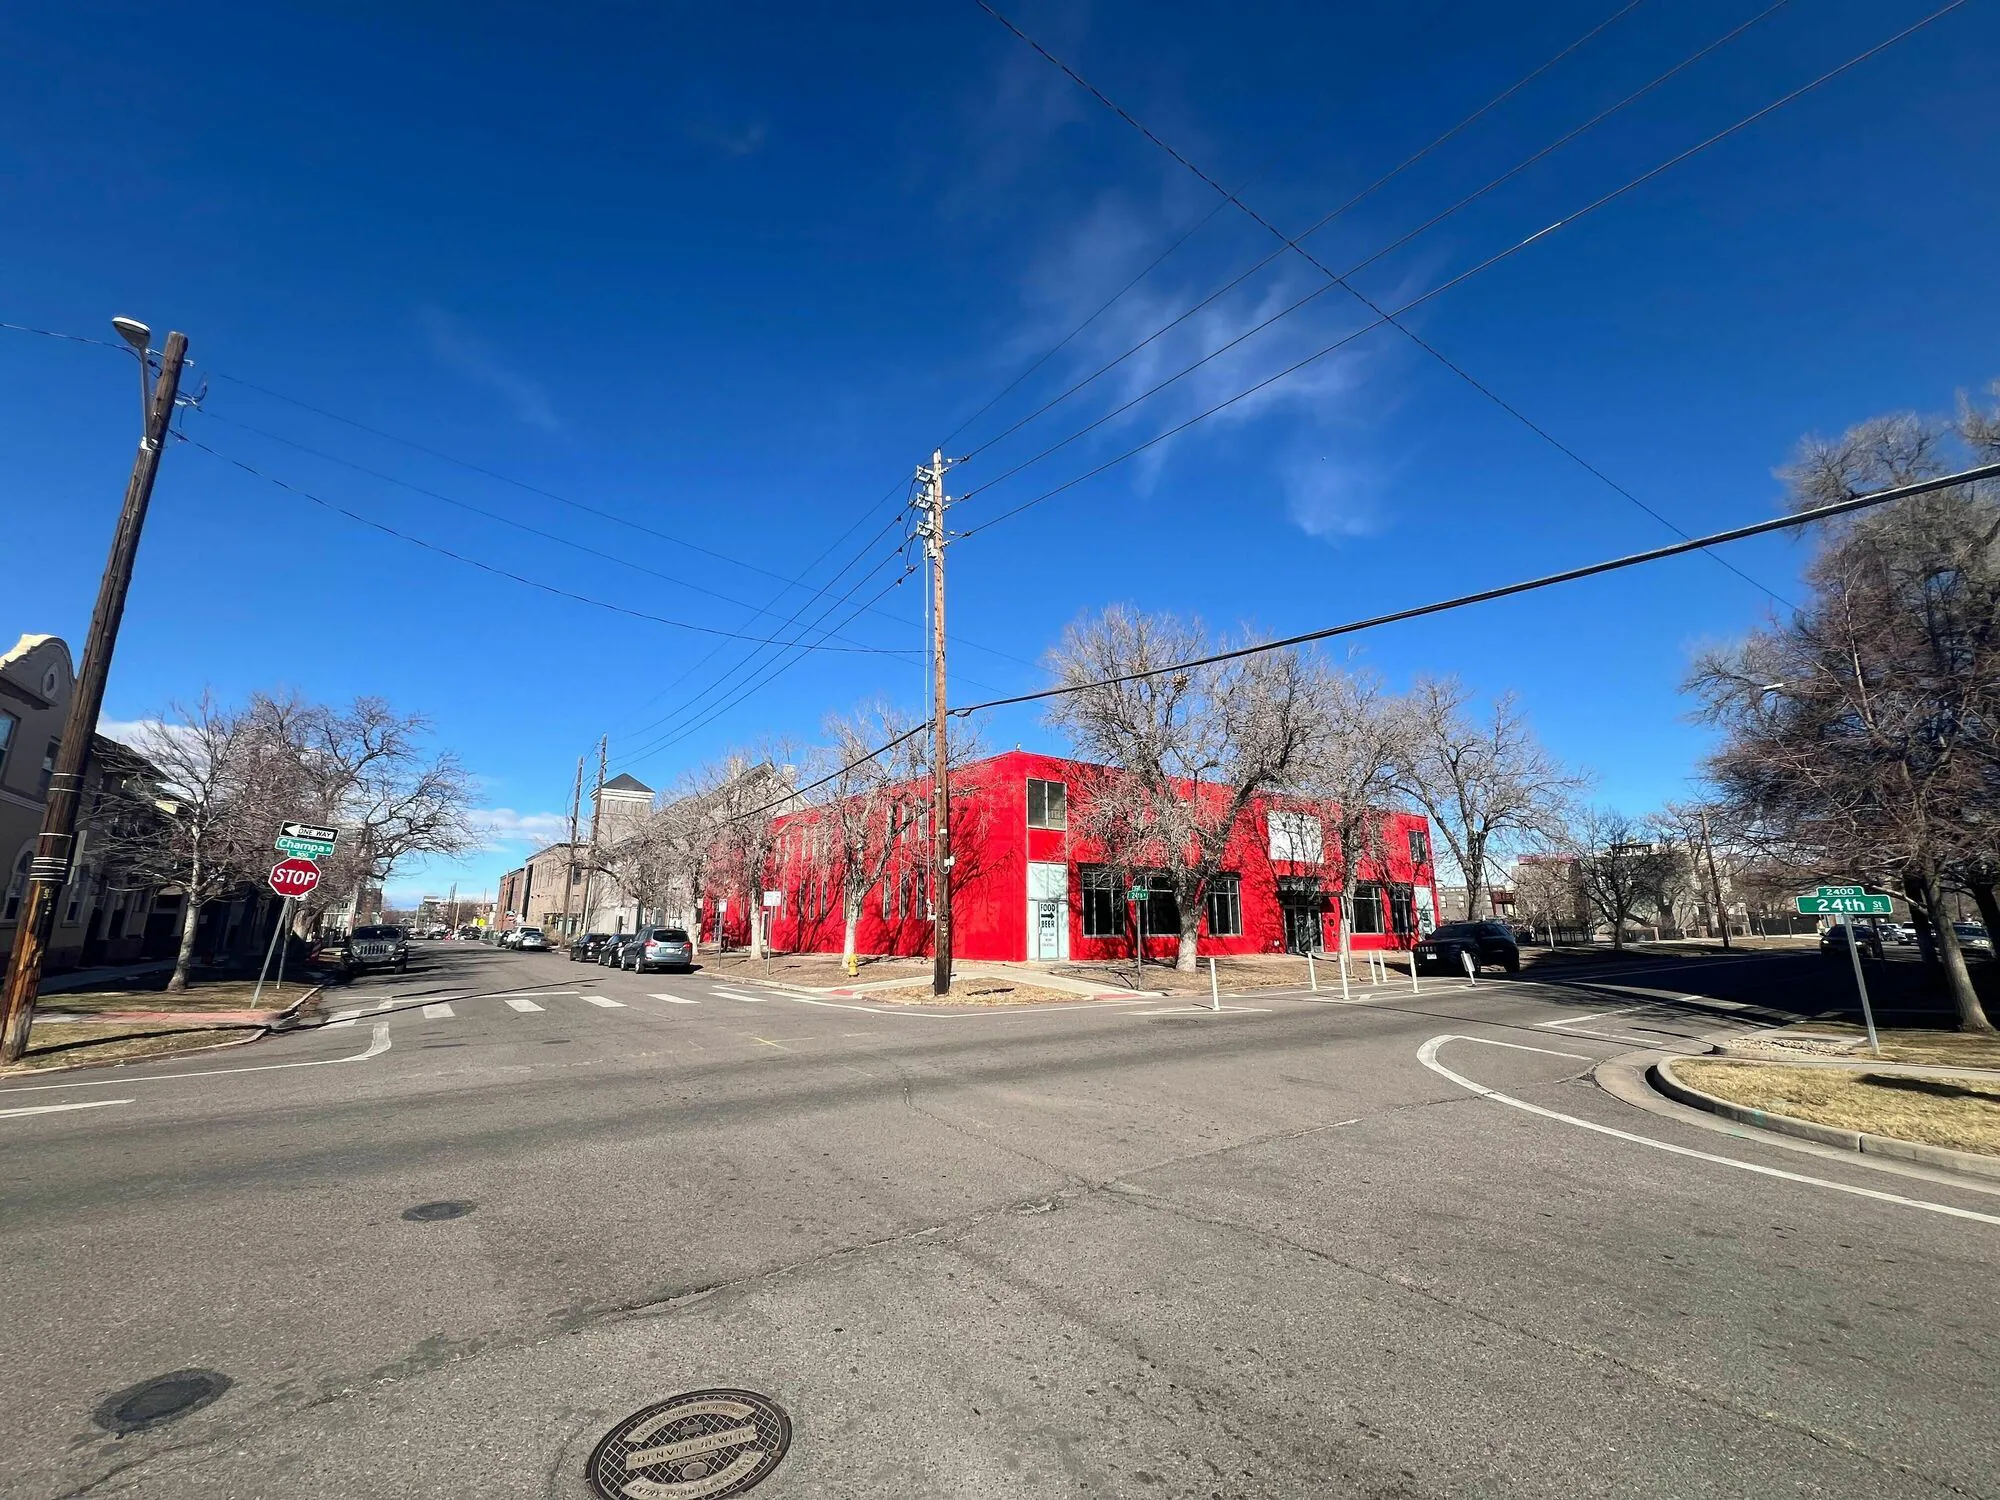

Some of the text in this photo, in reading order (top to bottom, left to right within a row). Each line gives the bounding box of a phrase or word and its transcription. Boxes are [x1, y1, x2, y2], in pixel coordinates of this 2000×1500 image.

[278, 839, 325, 852] Champa
[273, 868, 317, 886] STOP
[1826, 888, 1855, 896] 2400
[1040, 903, 1056, 912] FOOD
[1816, 898, 1866, 912] 24th
[1041, 920, 1055, 928] BEER
[637, 1445, 692, 1463] DENVER
[630, 1484, 662, 1497] ENTRY
